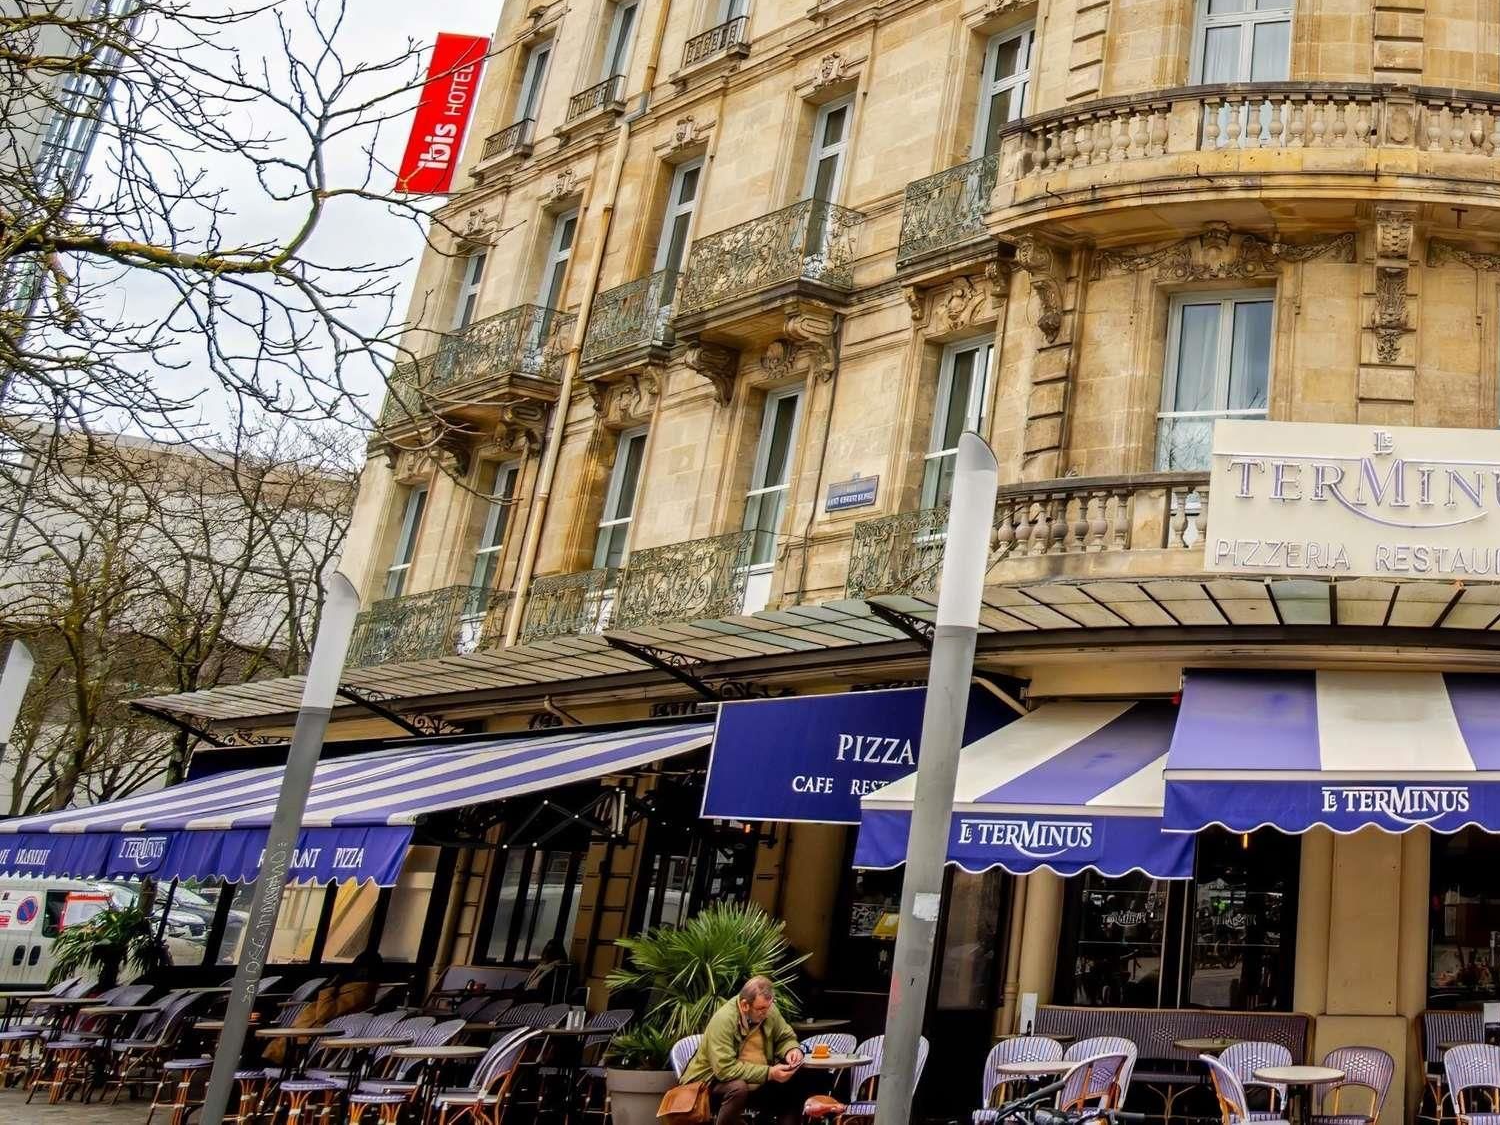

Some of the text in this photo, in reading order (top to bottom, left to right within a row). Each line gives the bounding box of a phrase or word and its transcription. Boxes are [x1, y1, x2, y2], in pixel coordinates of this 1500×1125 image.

[417, 63, 475, 170] ibis HOTEL
[1214, 539, 1350, 571] PIZZERIA
[836, 734, 916, 765] PIZZA
[792, 776, 834, 794] CAFE
[1342, 786, 1470, 823] TERMINUS
[978, 822, 1093, 857] TERMINUS
[332, 847, 364, 868] PIZZA
